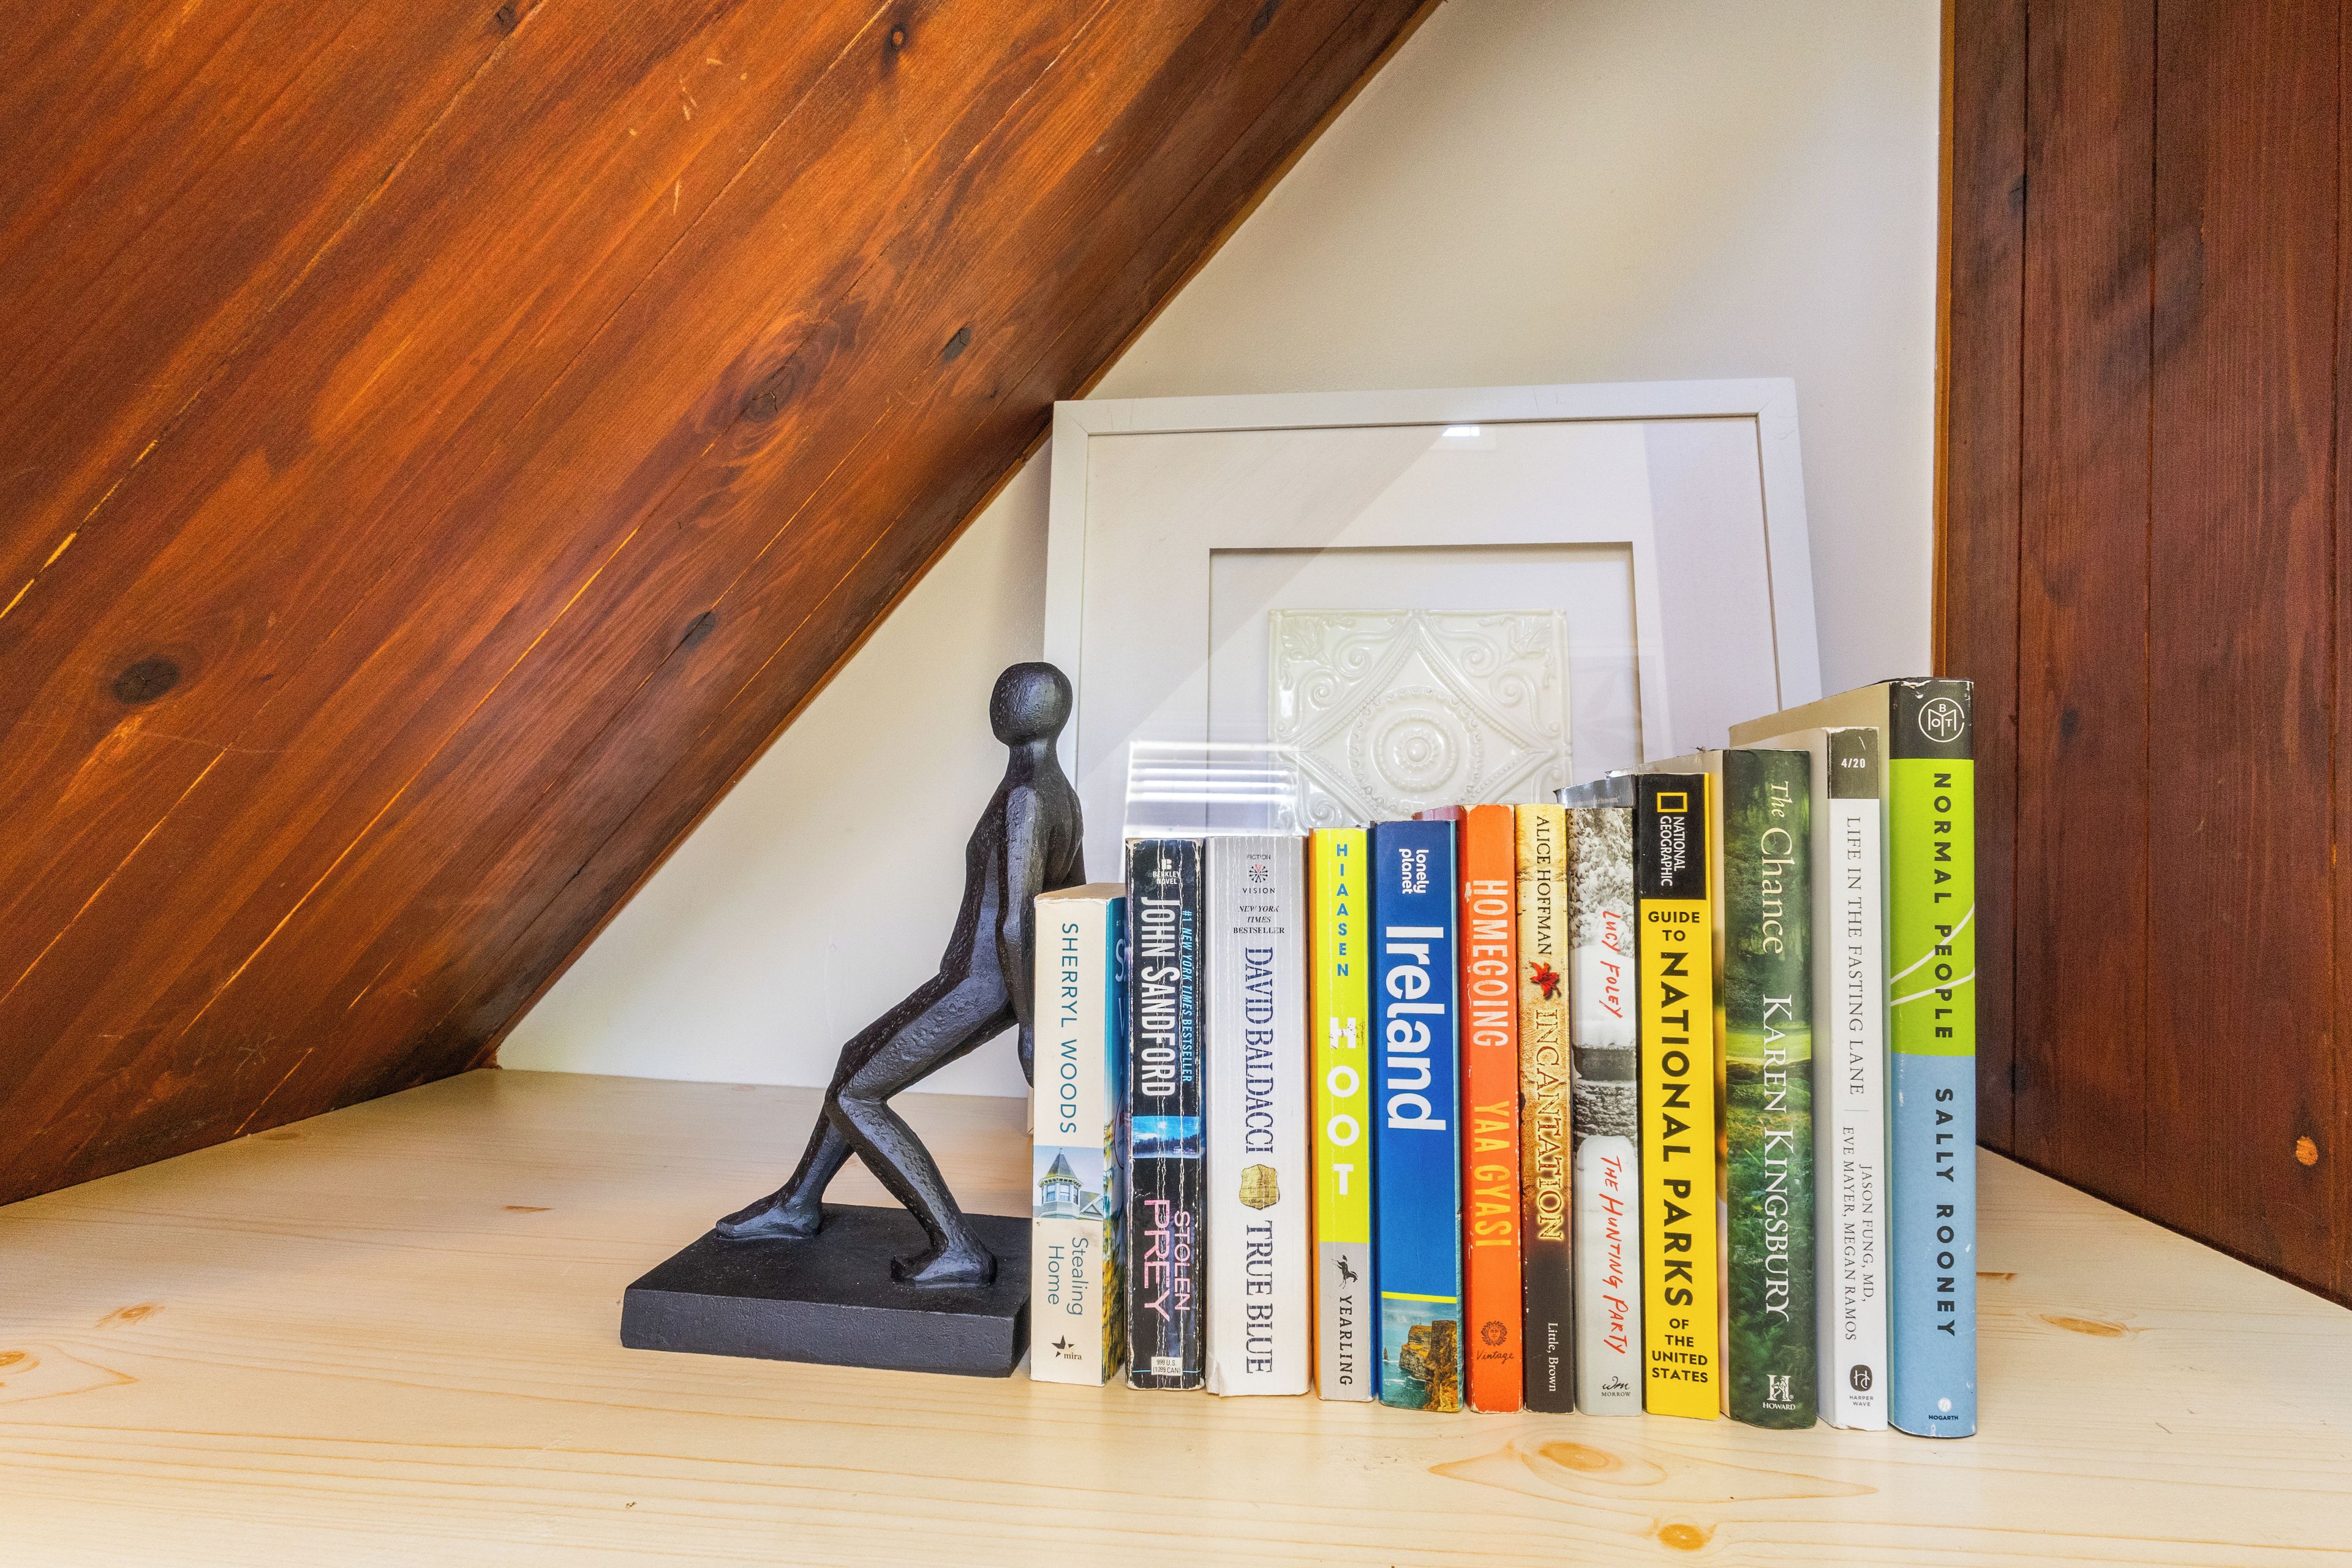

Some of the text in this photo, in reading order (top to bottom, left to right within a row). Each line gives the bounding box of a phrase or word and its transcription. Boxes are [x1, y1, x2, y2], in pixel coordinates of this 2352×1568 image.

[1841, 758, 1866, 768] 4/20
[1399, 848, 1413, 894] planet
[1415, 850, 1430, 894] lonely
[1536, 816, 1551, 956] ALICE HOFFMAN
[1660, 815, 1673, 886] GEOGRAPHIC
[1673, 816, 1686, 871] NATIONAL
[1760, 780, 1795, 954] The Chance
[1934, 773, 1953, 1038] NORMAL PEOPLE
[1336, 844, 1349, 976] HIAASEN
[1472, 880, 1509, 1047] HOMEGOING
[1648, 911, 1700, 923] GUIDE
[1662, 930, 1686, 941] TO
[1847, 816, 1864, 1095] LIFE IN THE FASTING LANE
[1060, 923, 1078, 1133] SHERRYL WOODS
[1141, 897, 1180, 1096] JOHN SANDFORD
[1182, 910, 1193, 1082] #1 NEW YORK TIMES BESTSELLER
[1245, 948, 1273, 1153] DAVID BALDACCI
[1385, 927, 1446, 1130] Ireland
[1327, 1017, 1360, 1195] HOOT
[1536, 1009, 1563, 1240] INCANTATION
[1660, 952, 1693, 1306] NATIONAL PARKS
[1763, 994, 1794, 1322] KAREN KINGSBURY
[1474, 1101, 1512, 1247] YAA GYASI
[1843, 1126, 1856, 1341] EVE MAYER, MEGAN RAMOS
[1859, 1165, 1874, 1302] JASON FUNG, MD,
[1935, 1088, 1955, 1336] SALLY ROONEY
[1049, 1246, 1064, 1305] Home
[1067, 1237, 1088, 1315] Stealing
[1144, 1200, 1169, 1322] PREY
[1175, 1211, 1190, 1310] STOLEN
[1246, 1221, 1273, 1373] TRUE BLUE
[1669, 1318, 1689, 1329] OF
[1064, 1352, 1082, 1360] mira
[1340, 1295, 1352, 1385] YEARLING
[1476, 1349, 1515, 1363] Vintage
[1548, 1323, 1559, 1392] Little, Brown
[1652, 1350, 1708, 1366] UNITED
[1652, 1367, 1708, 1383] STATES
[1665, 1335, 1694, 1348] THE
[1763, 1402, 1795, 1411] HOWARD
